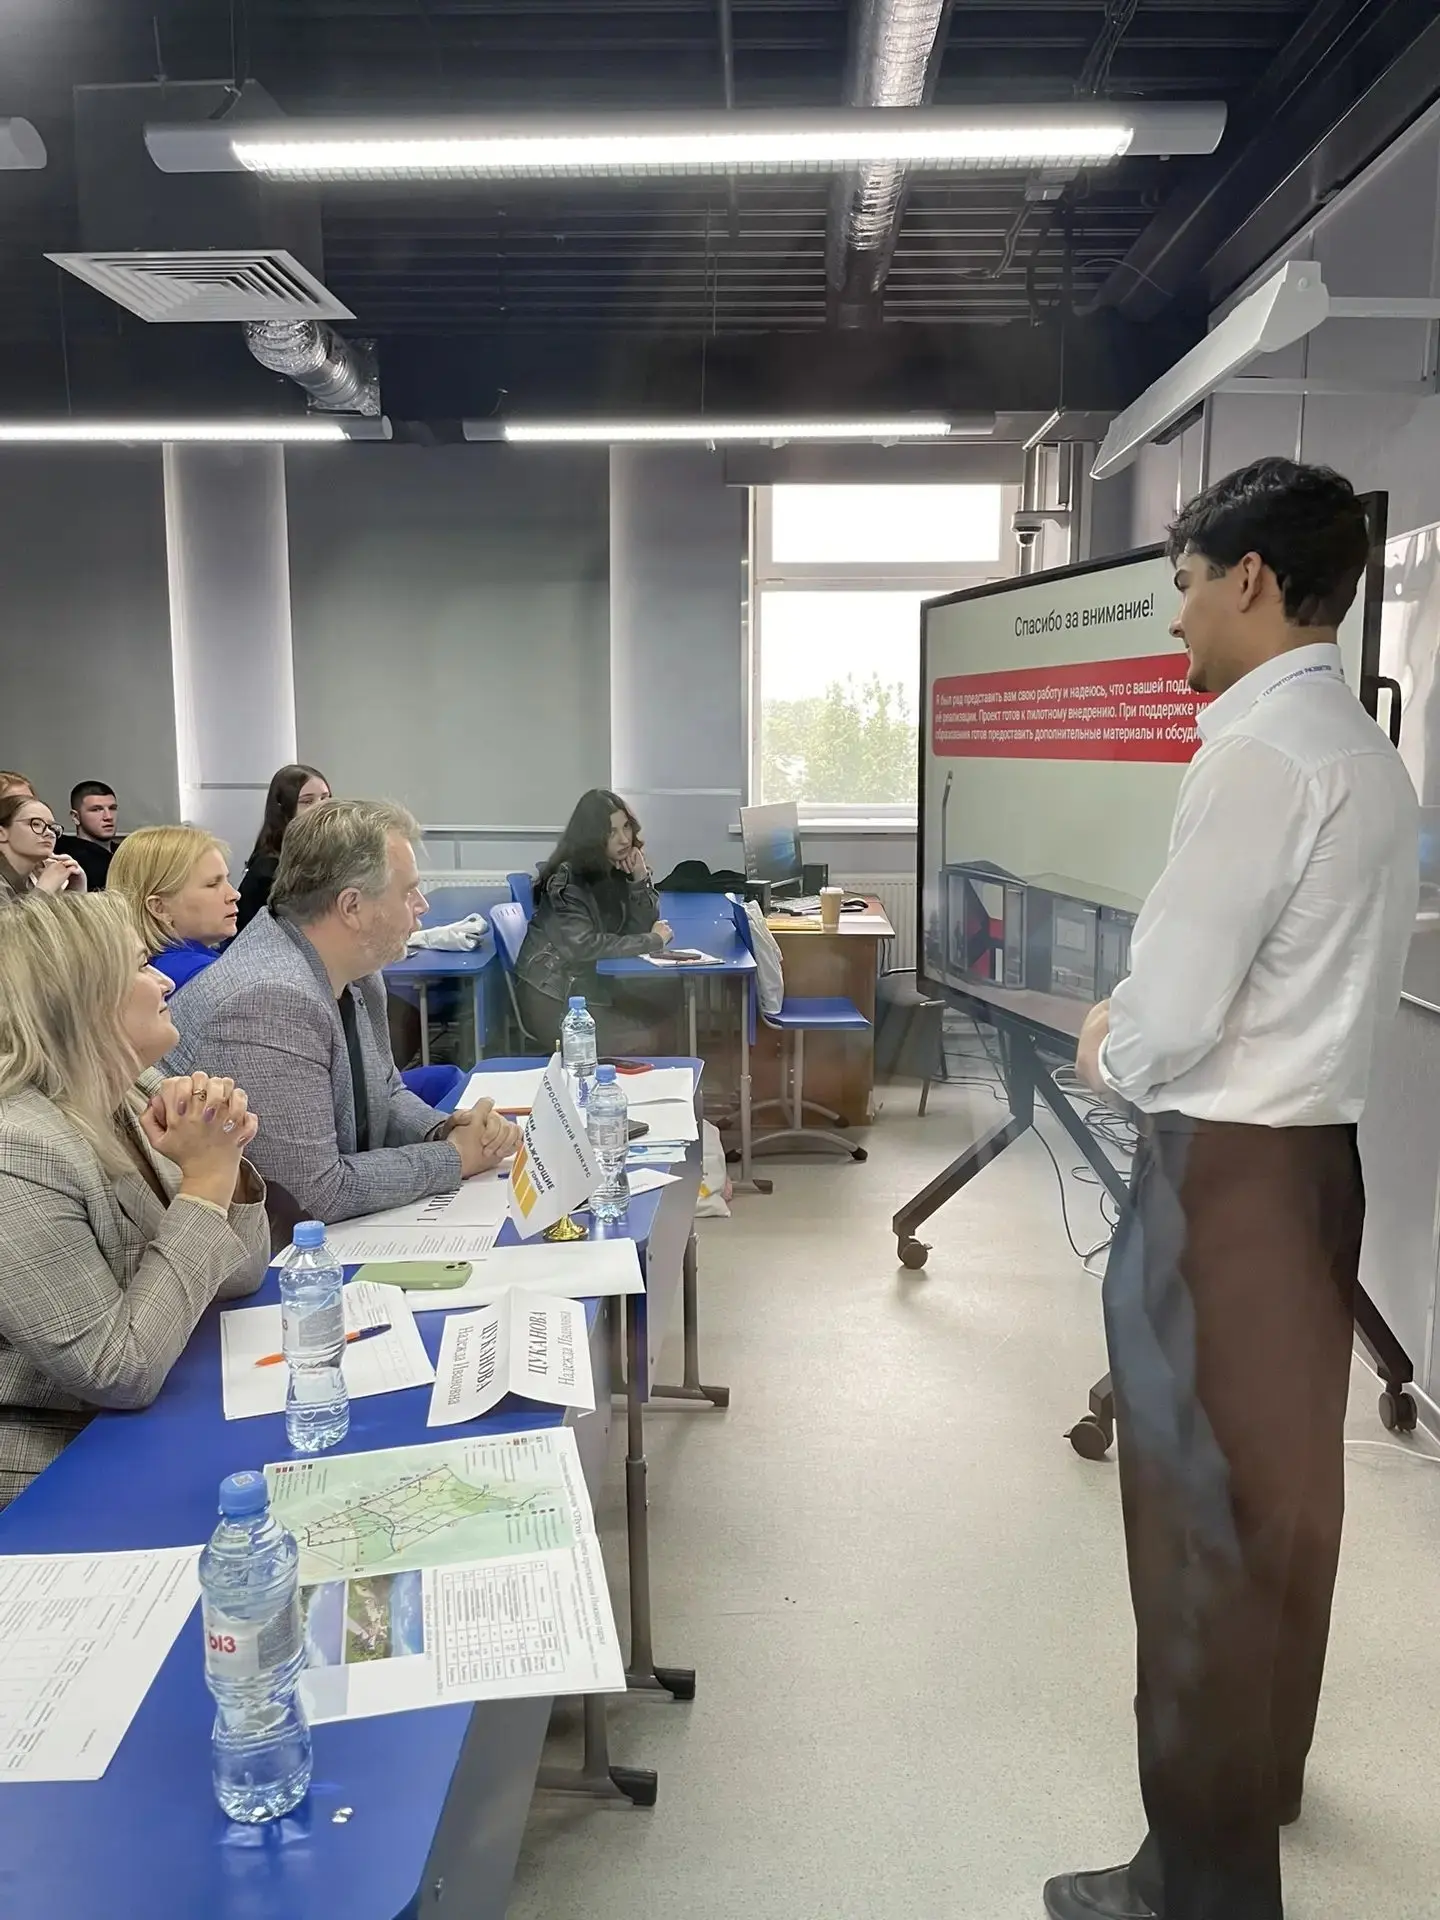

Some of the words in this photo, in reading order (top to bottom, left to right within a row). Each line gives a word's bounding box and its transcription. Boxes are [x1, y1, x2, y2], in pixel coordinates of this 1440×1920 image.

[1015, 609, 1062, 635] Спасибо
[1065, 611, 1079, 629] за
[1083, 593, 1154, 625] внимание!
[964, 692, 1002, 707] представить
[1003, 691, 1017, 702] вам
[1017, 691, 1036, 702] свою
[1036, 685, 1063, 703] работу
[1063, 688, 1068, 698] и
[1070, 684, 1108, 699] надеюсь,
[1109, 685, 1124, 696] что
[1126, 685, 1132, 695] с
[1133, 677, 1164, 695] вашей
[1166, 679, 1199, 695] подд
[978, 708, 1001, 725] Проект
[1002, 710, 1020, 721] готов
[1021, 710, 1026, 721] к
[1027, 708, 1067, 723] пилотному
[1068, 706, 1117, 721] внедрению.
[1119, 702, 1136, 721] При
[1139, 702, 1194, 720] поддержке
[971, 729, 987, 740] готов
[988, 728, 1034, 743] предоставить
[1034, 727, 1101, 742] дополнительные
[1103, 726, 1154, 743] материалы
[1157, 728, 1163, 740] и
[1165, 723, 1200, 744] обсуди
[573, 1143, 592, 1180] КОНКУРС
[530, 1170, 545, 1196] ГОРОДА
[452, 1326, 475, 1364] Надежда
[476, 1319, 499, 1393] ЦУКАНОВА
[528, 1310, 548, 1376] ЦУКАНОВА
[447, 1361, 470, 1406] Ивановна
[558, 1349, 575, 1388] Надежда
